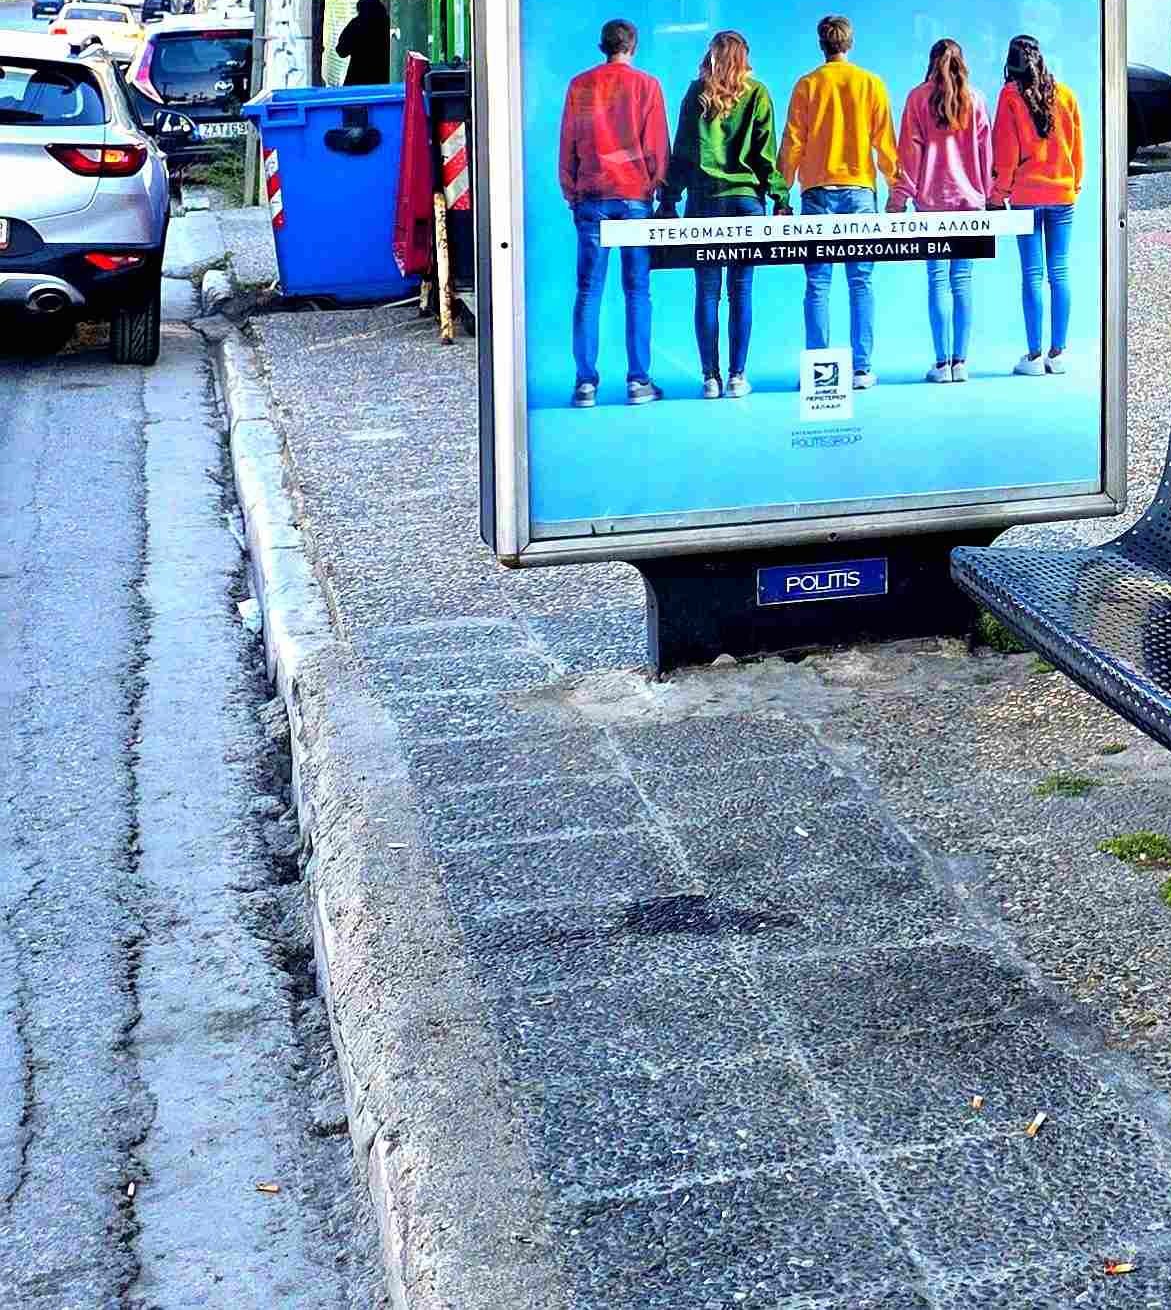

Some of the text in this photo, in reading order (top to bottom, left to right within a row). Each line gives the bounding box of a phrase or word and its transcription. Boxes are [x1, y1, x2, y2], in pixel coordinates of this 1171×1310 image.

[648, 218, 991, 240] ΣΤΕΚΟΜΑΣΤΕ Ο ΕΝΑΣ ΔΙΠΛΑ ΣΤΟΝ ΑΛΛΟΝ
[696, 241, 952, 261] ΕΝΑΝΤΙΑ ΣΤΗΝ ΕΝΔΟΣΧΟΛΙΚΗ ΒΙΑ
[787, 571, 860, 593] POLITIS
